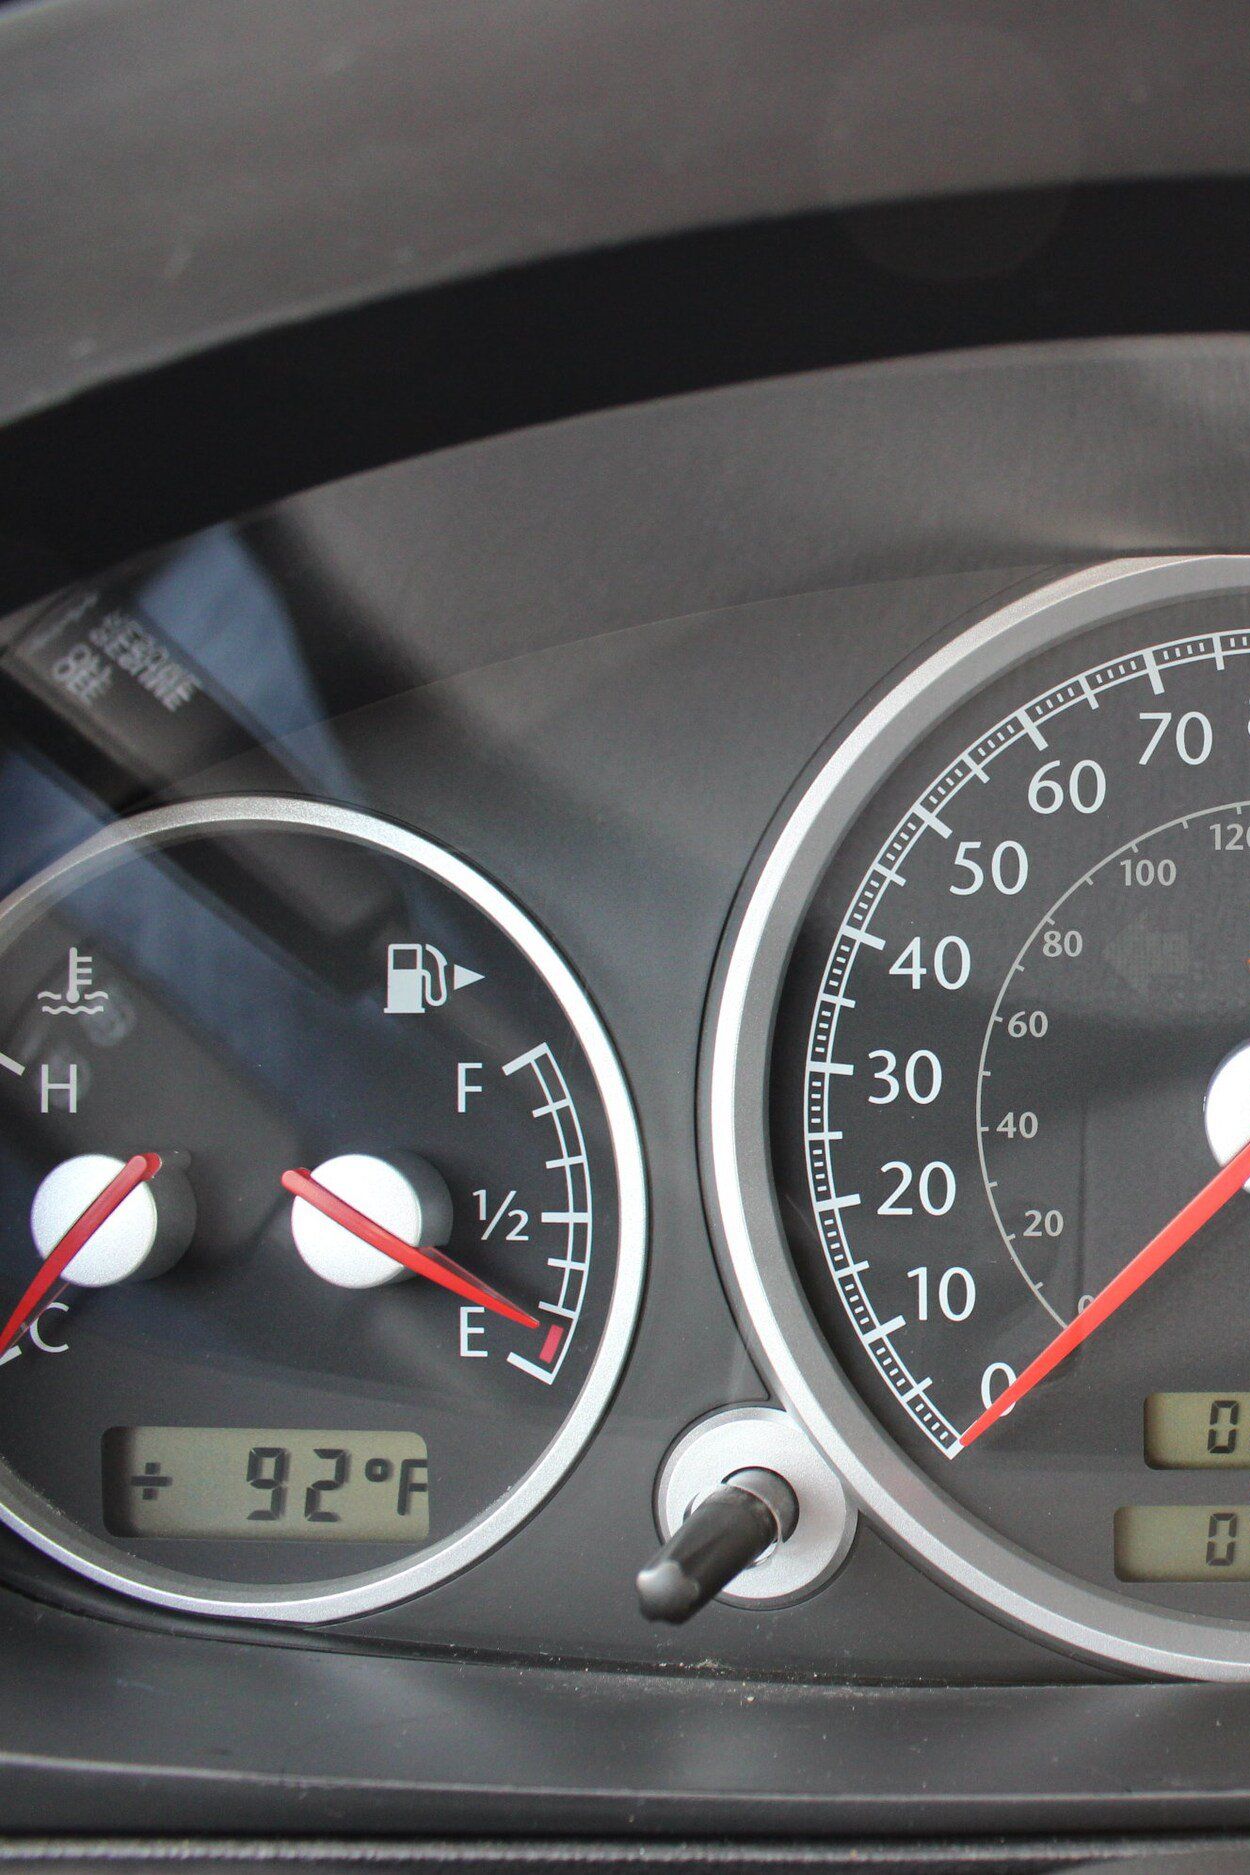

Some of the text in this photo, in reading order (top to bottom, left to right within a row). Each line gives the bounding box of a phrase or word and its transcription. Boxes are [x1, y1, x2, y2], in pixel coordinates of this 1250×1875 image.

[1139, 712, 1212, 765] 70
[1028, 760, 1106, 814] 60
[950, 841, 1028, 895] 50
[1121, 859, 1176, 886] 100
[889, 936, 970, 989] 40
[1043, 931, 1082, 957] 80
[1008, 1011, 1048, 1037] 60
[42, 1064, 77, 1113] H
[458, 1063, 482, 1112] F
[869, 1050, 942, 1104] 30
[997, 1112, 1038, 1138] 40
[877, 1161, 956, 1215] 20
[1023, 1210, 1063, 1236] 20
[908, 1267, 975, 1321] 10
[30, 1302, 69, 1352] C
[460, 1307, 485, 1357] E
